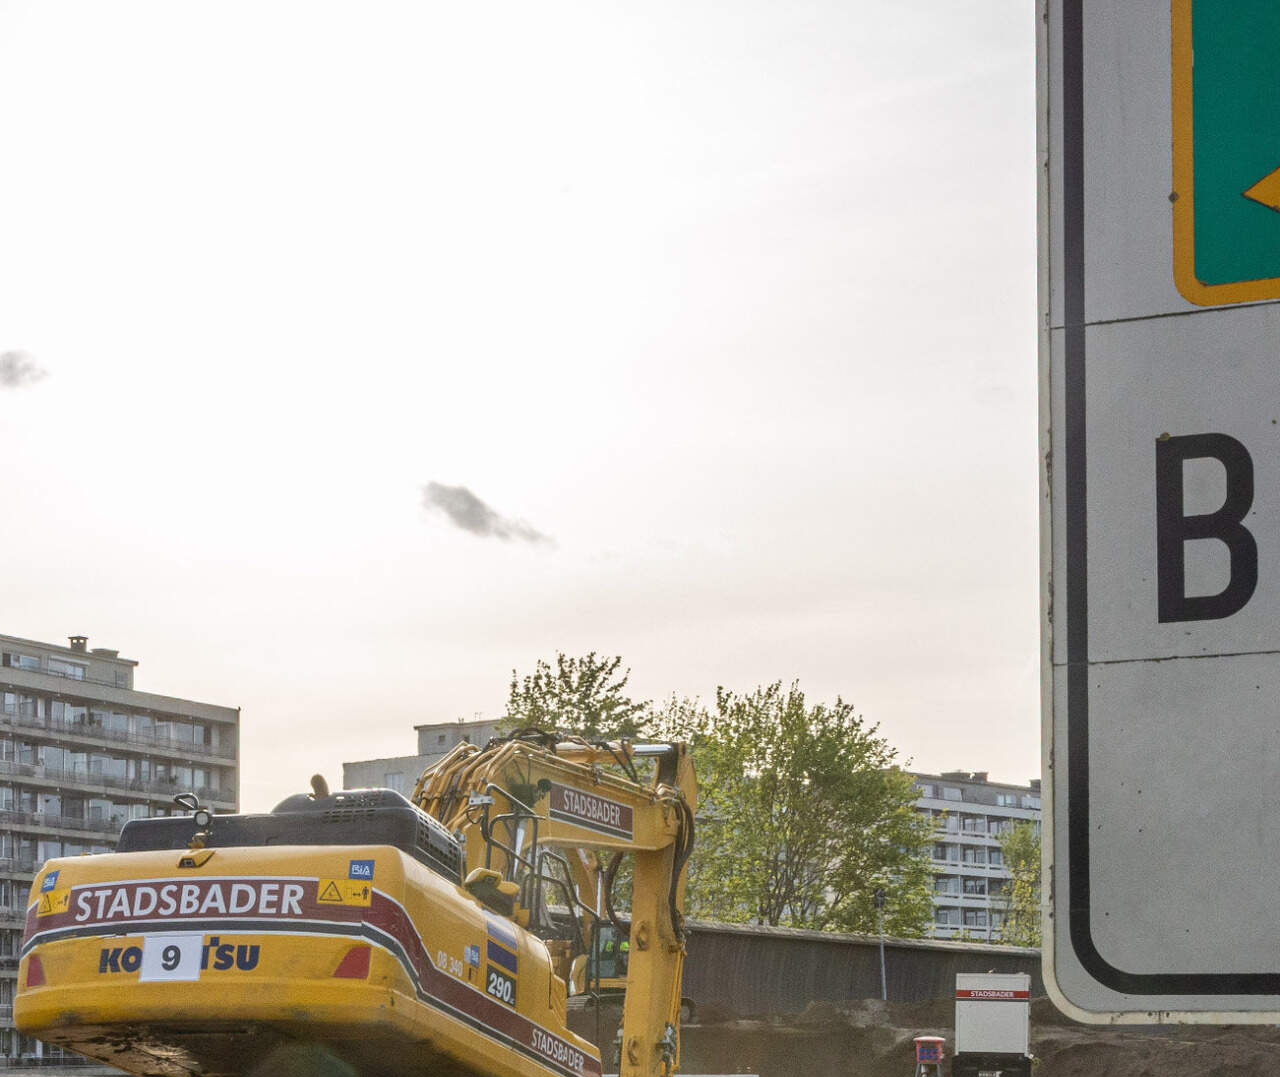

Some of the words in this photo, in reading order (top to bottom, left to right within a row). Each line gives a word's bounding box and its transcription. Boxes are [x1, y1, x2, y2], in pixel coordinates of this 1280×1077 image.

[563, 789, 621, 826] STADSBADER
[75, 883, 304, 922] STADSBADER
[161, 944, 182, 972] 9
[487, 972, 512, 1002] 290
[970, 990, 1015, 998] STADSBADER
[531, 1028, 585, 1074] STADSBADER
